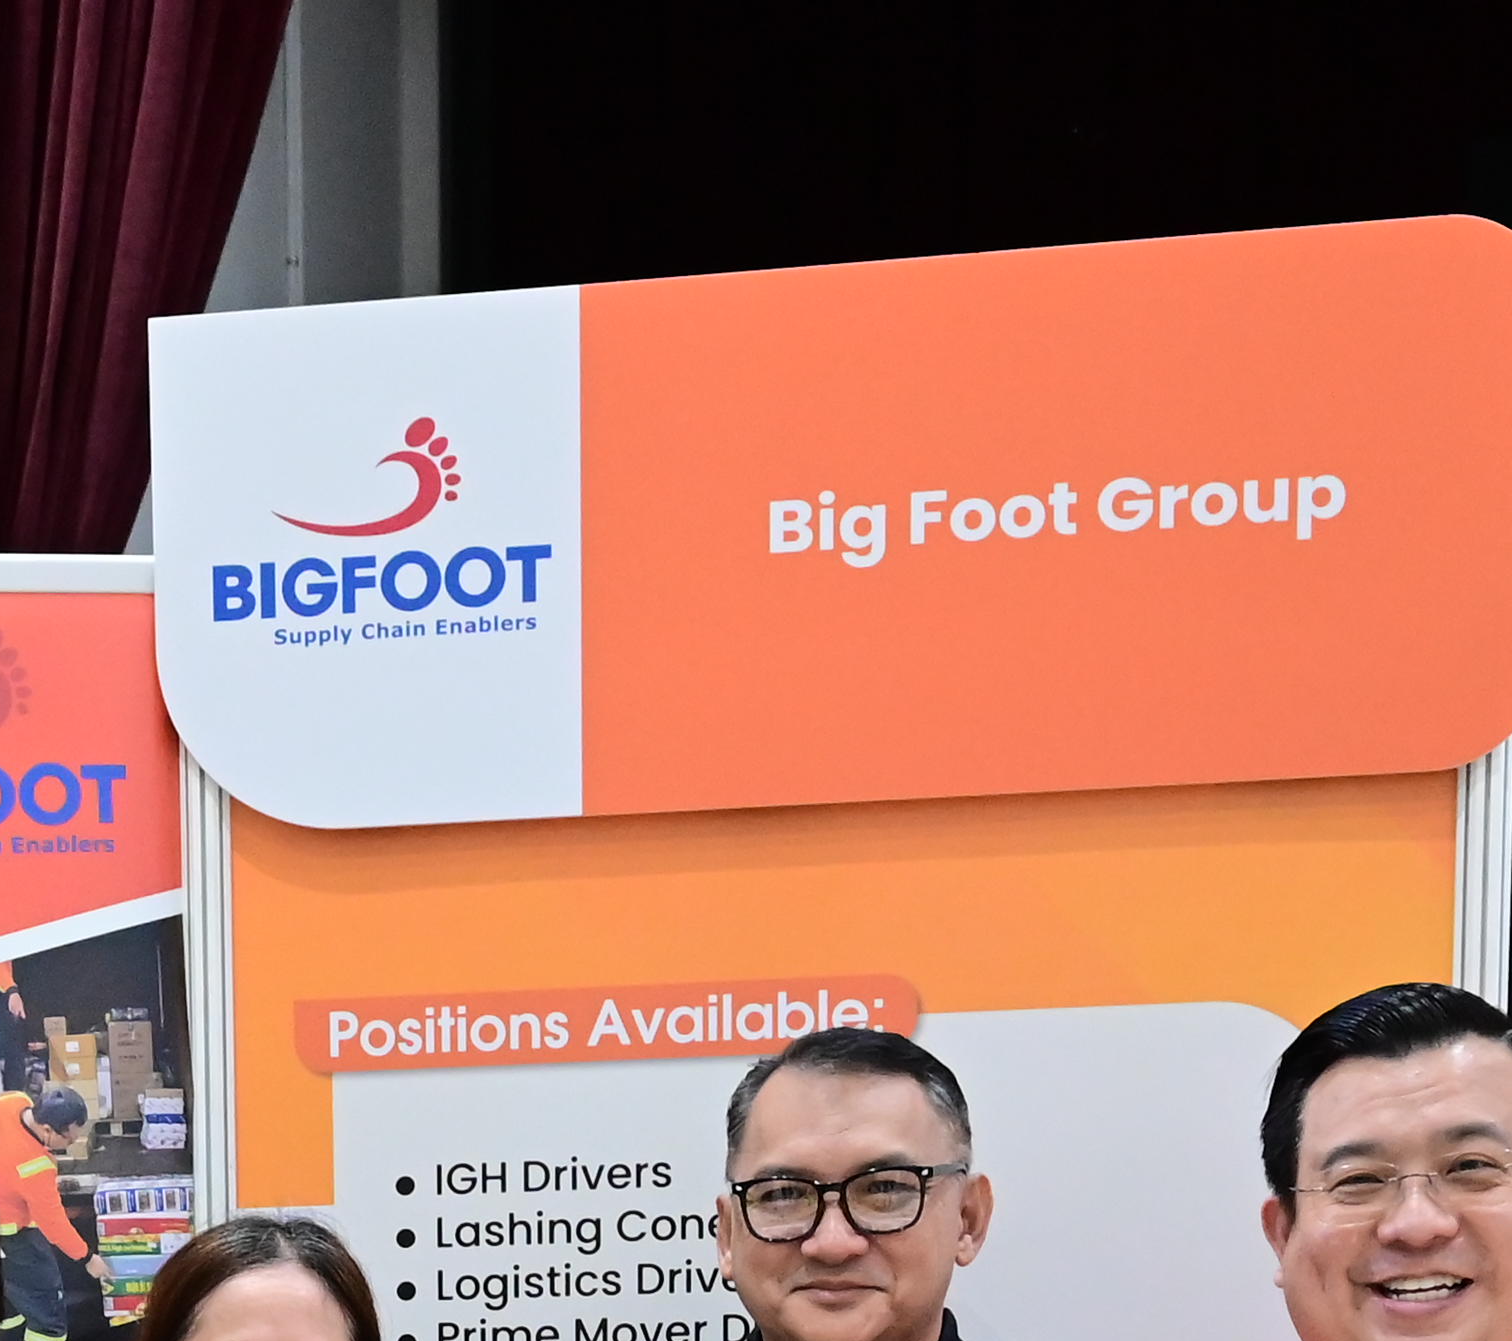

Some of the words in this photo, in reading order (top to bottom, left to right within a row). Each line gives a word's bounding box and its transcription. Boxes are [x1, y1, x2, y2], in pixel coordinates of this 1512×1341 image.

[770, 490, 886, 567] Big
[910, 476, 1080, 548] Foot
[1097, 467, 1347, 539] Group
[212, 544, 553, 622] BIGFOOT
[274, 622, 353, 647] Supply
[363, 619, 428, 641] Chain
[435, 613, 538, 635] Enablers
[12, 836, 115, 854] Enablers
[329, 1006, 568, 1058] Positions
[588, 990, 884, 1047] Available:
[435, 1161, 508, 1196] IGH
[523, 1155, 672, 1193] Drivers
[436, 1211, 602, 1255] Lashing
[437, 1264, 622, 1310] Logistics
